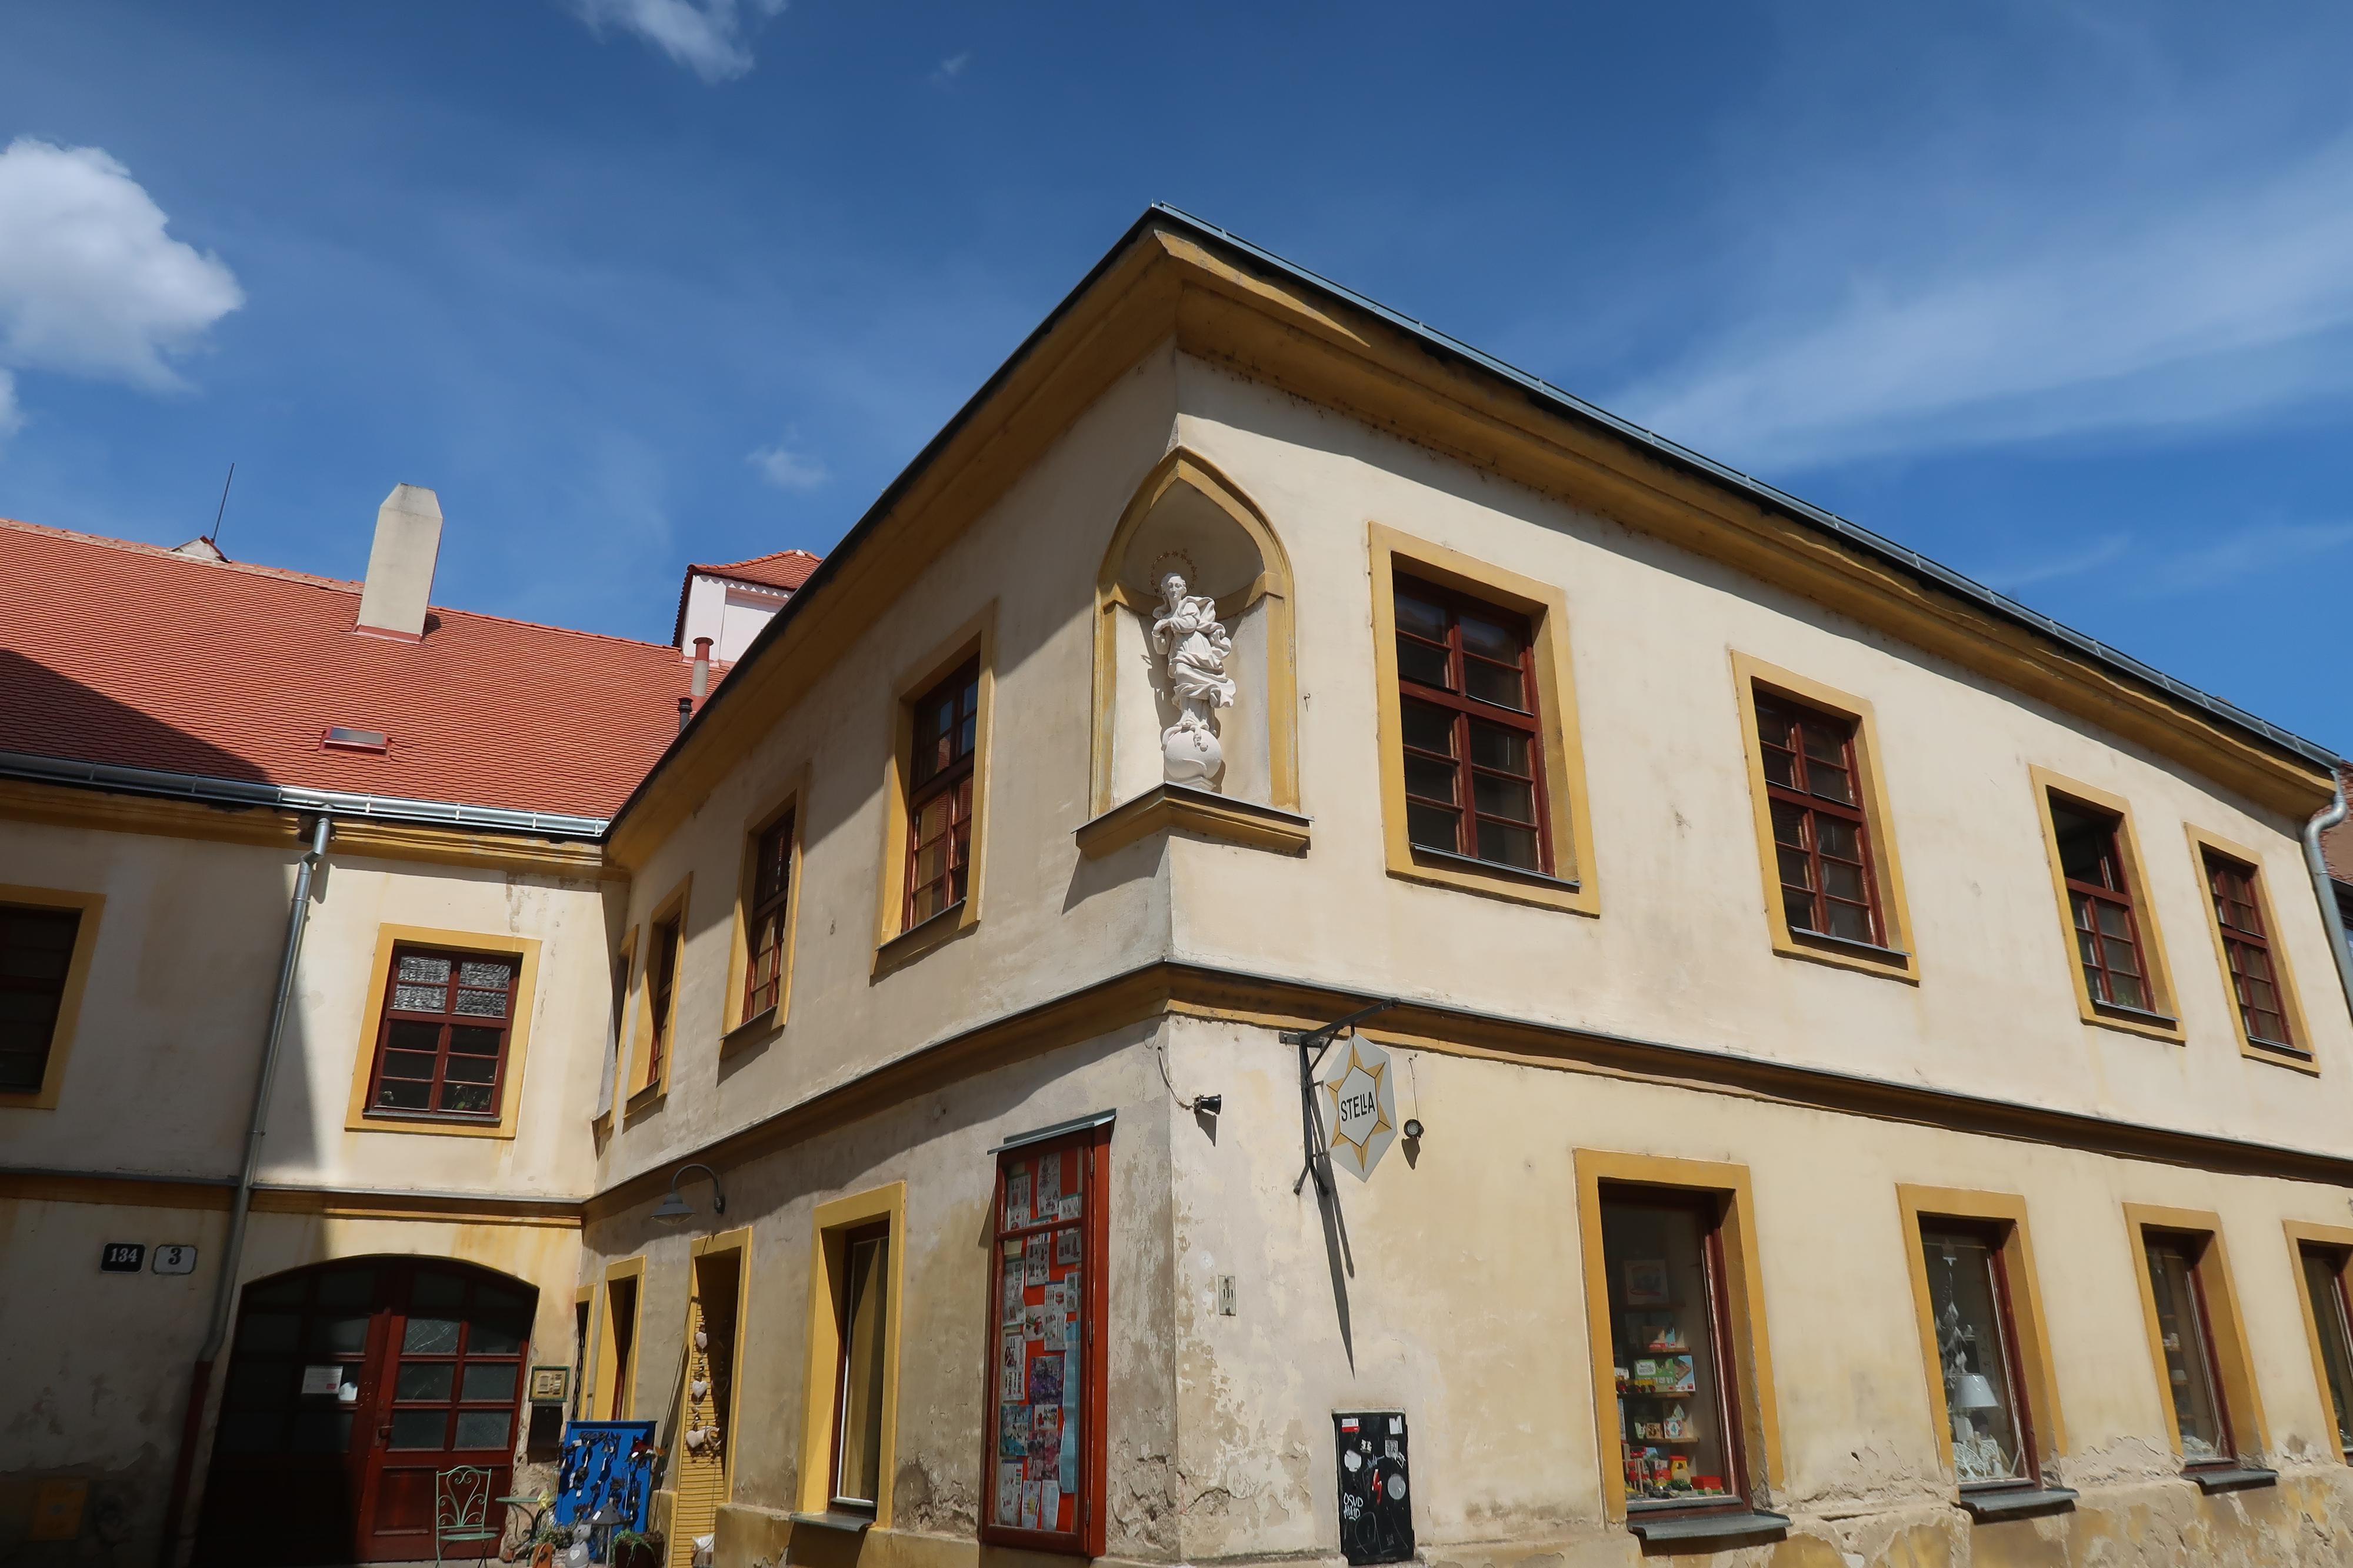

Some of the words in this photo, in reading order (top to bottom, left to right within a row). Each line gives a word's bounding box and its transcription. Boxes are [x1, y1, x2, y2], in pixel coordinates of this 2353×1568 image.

[1341, 1091, 1375, 1122] STELLA
[109, 1247, 138, 1262] 134
[168, 1247, 182, 1265] 3
